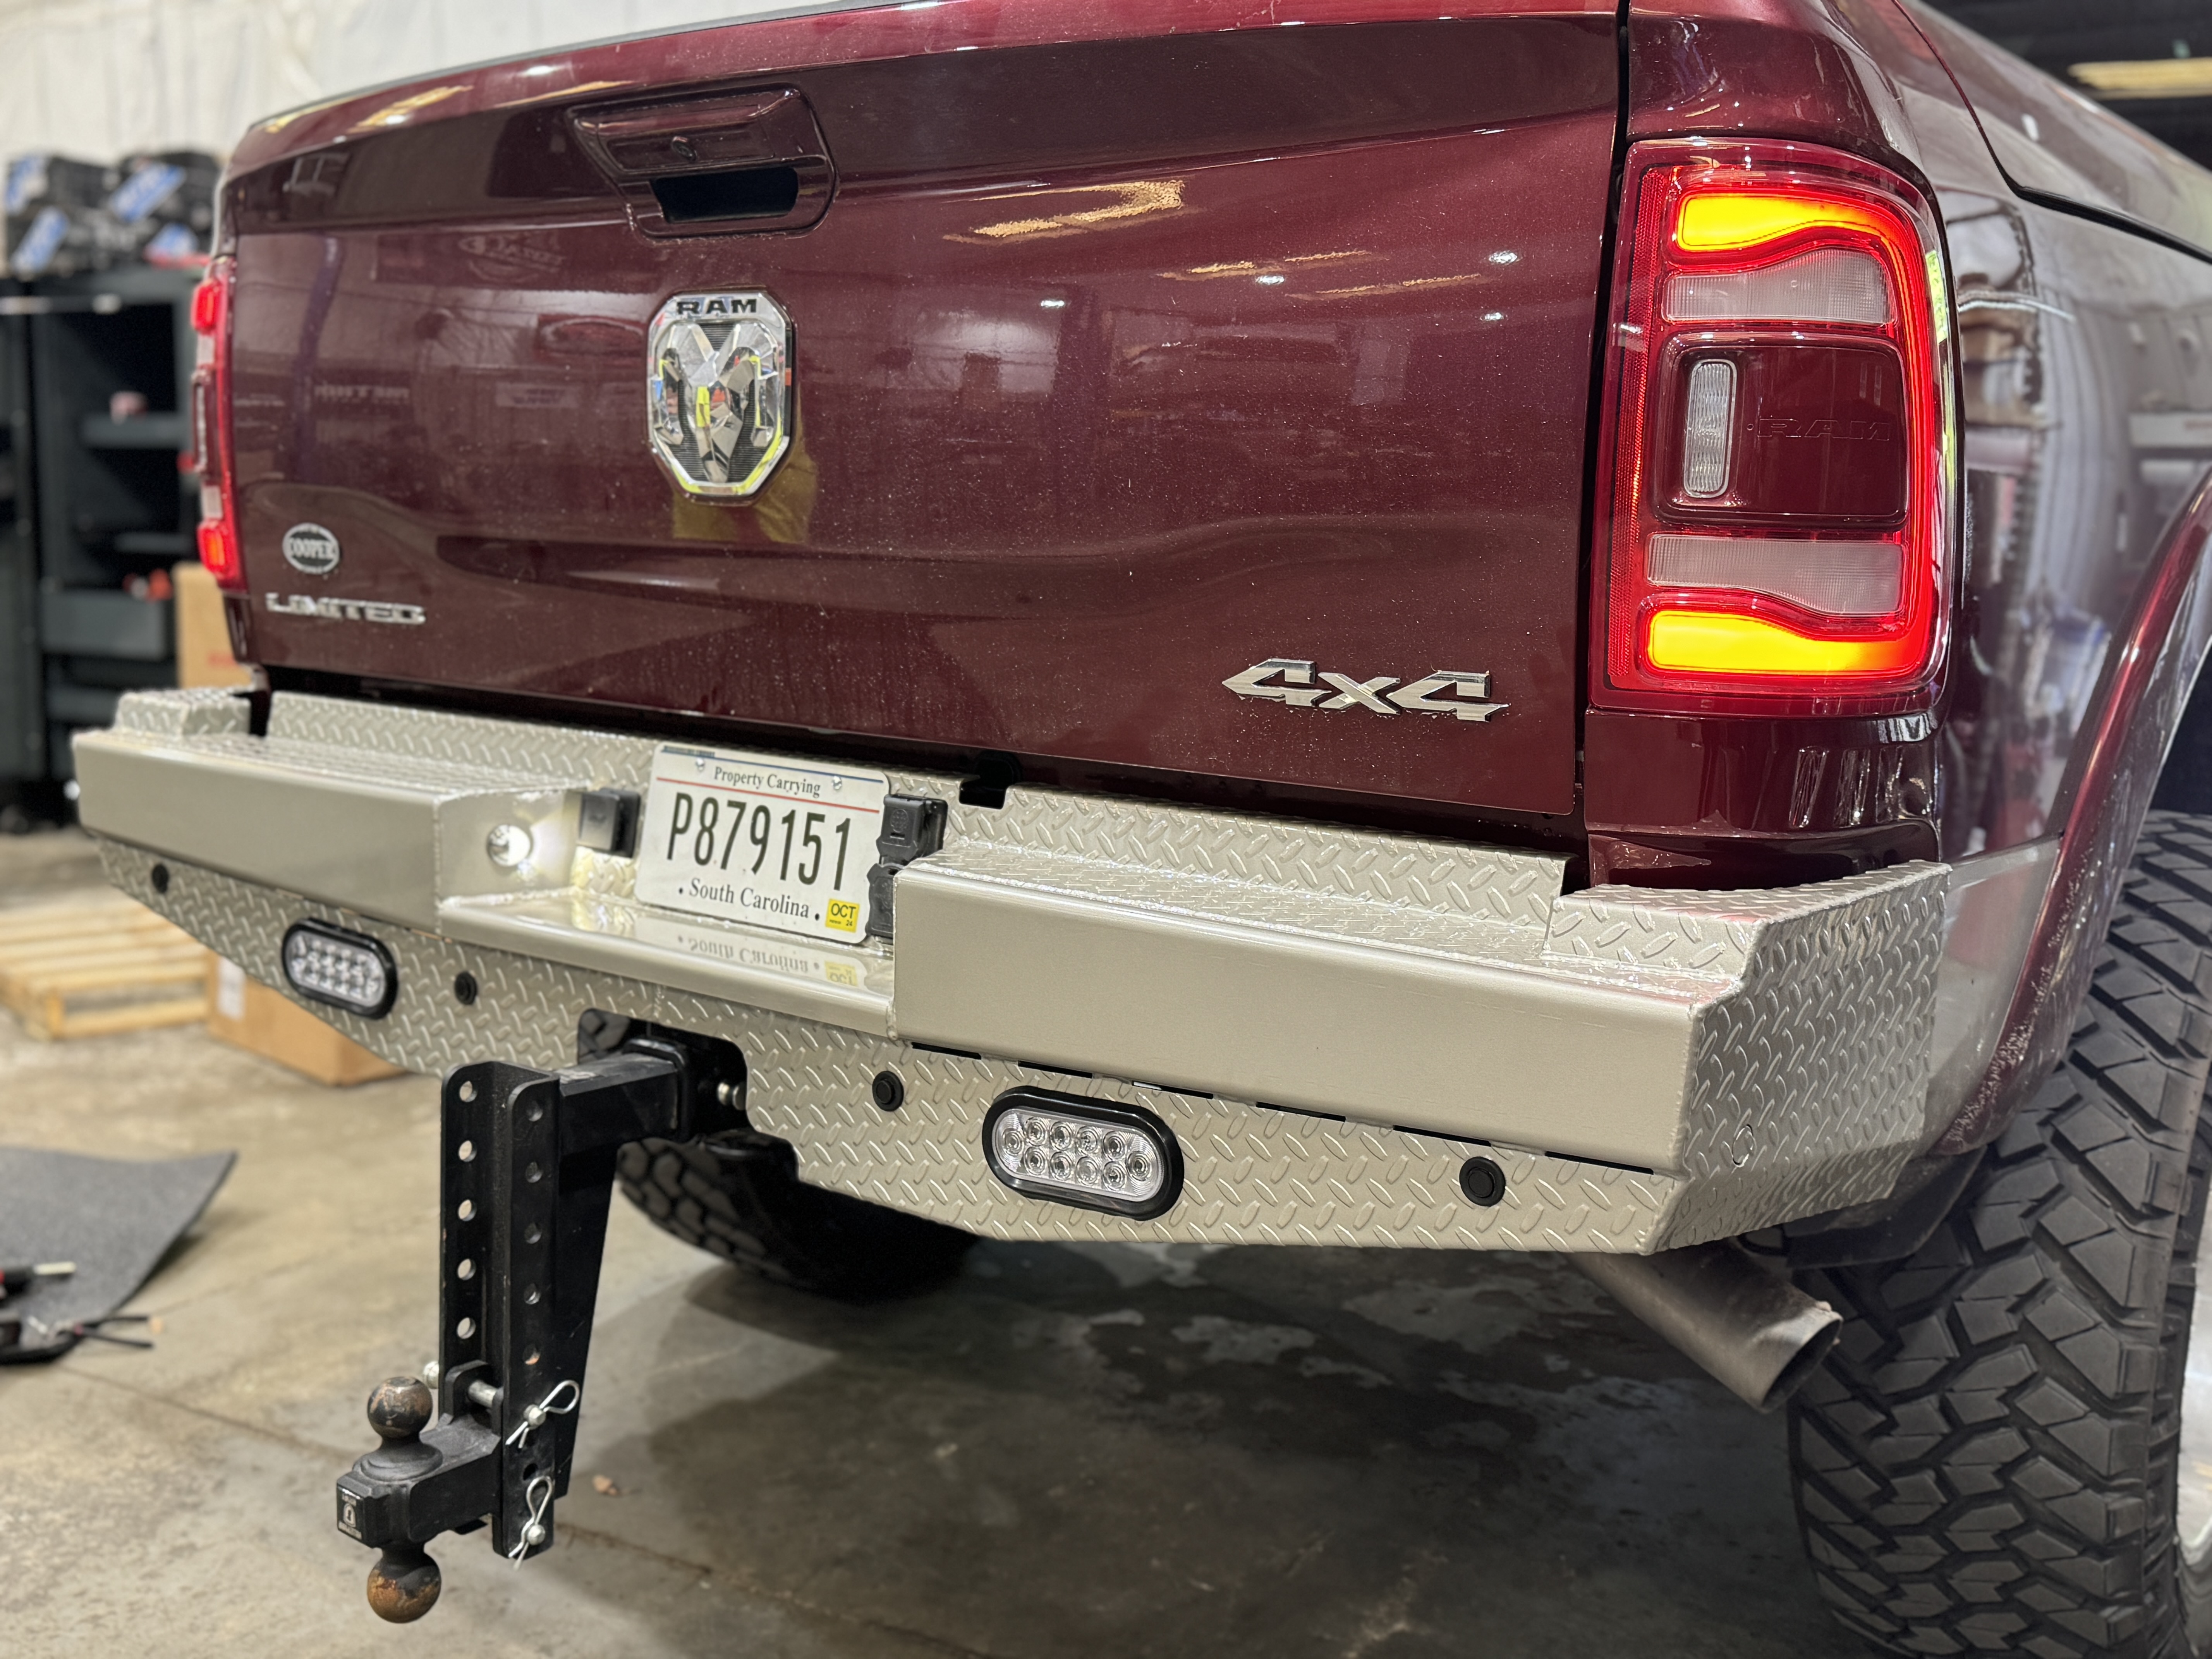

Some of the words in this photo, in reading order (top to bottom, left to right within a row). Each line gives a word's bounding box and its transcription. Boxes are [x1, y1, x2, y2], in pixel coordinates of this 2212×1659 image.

[677, 298, 757, 315] RAM
[1757, 418, 1889, 441] RAM
[265, 592, 426, 625] LIMITED
[713, 766, 764, 789] Property
[766, 773, 821, 797] Carrying
[667, 792, 851, 891] P879151
[689, 878, 734, 904] South
[740, 888, 809, 919] Carolina
[831, 903, 857, 919] OCT
